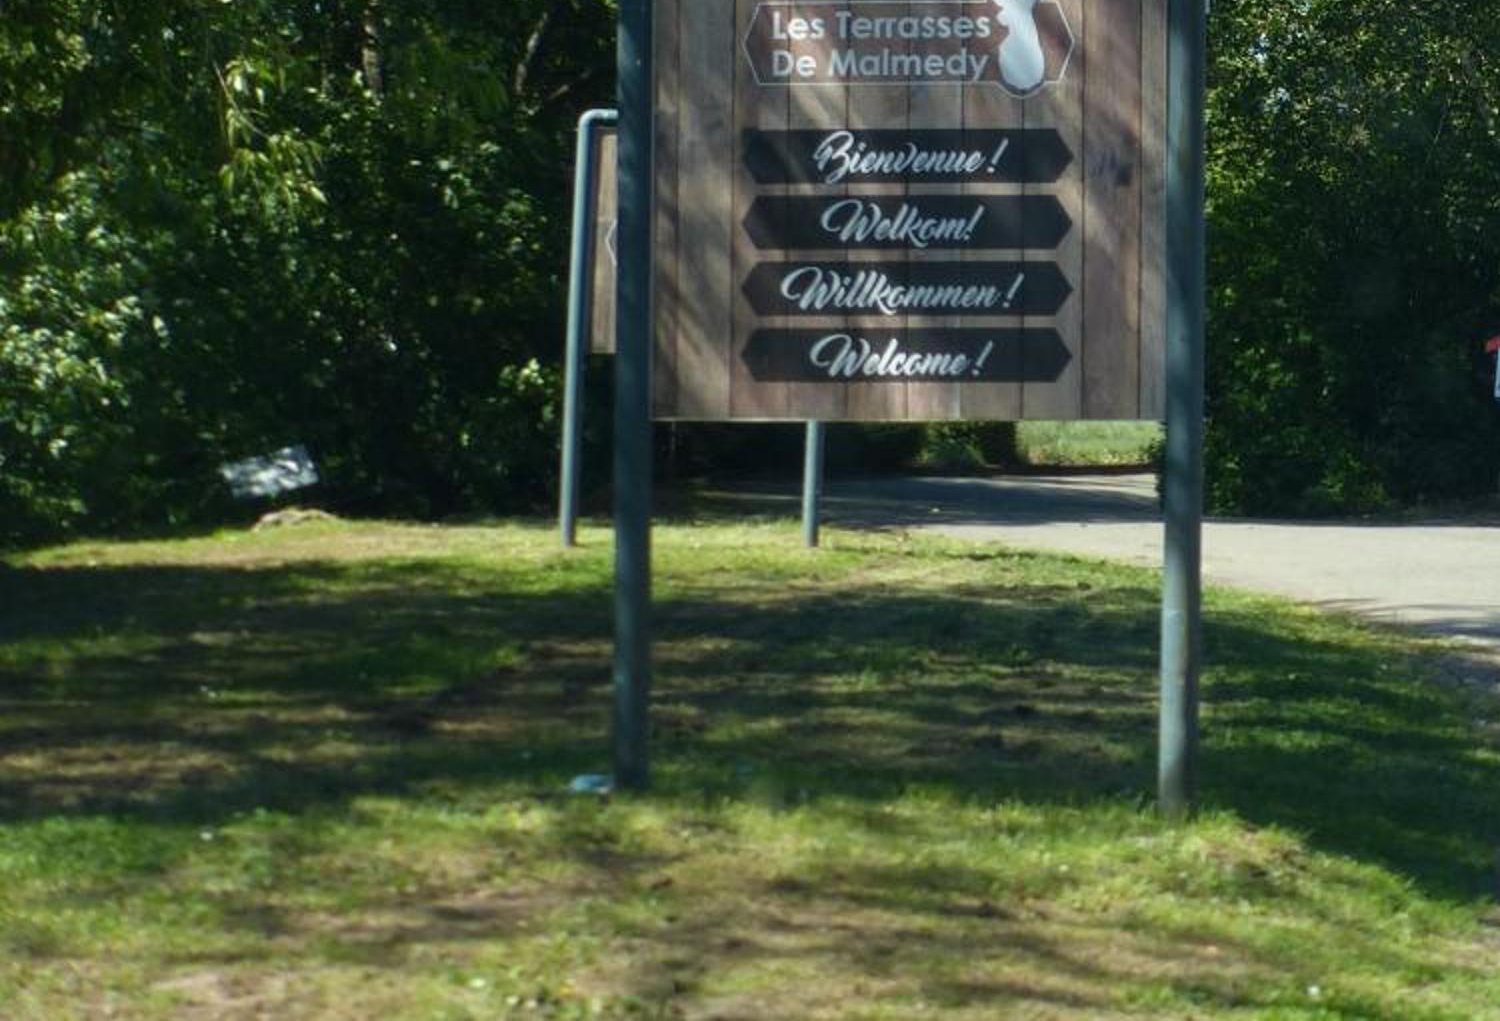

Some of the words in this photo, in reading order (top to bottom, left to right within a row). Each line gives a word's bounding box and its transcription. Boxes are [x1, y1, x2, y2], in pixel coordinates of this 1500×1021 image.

[773, 12, 825, 39] Les
[836, 11, 991, 39] Terrasses
[773, 50, 815, 77] De
[828, 49, 988, 81] Malmedy
[822, 200, 984, 248] Welkom!
